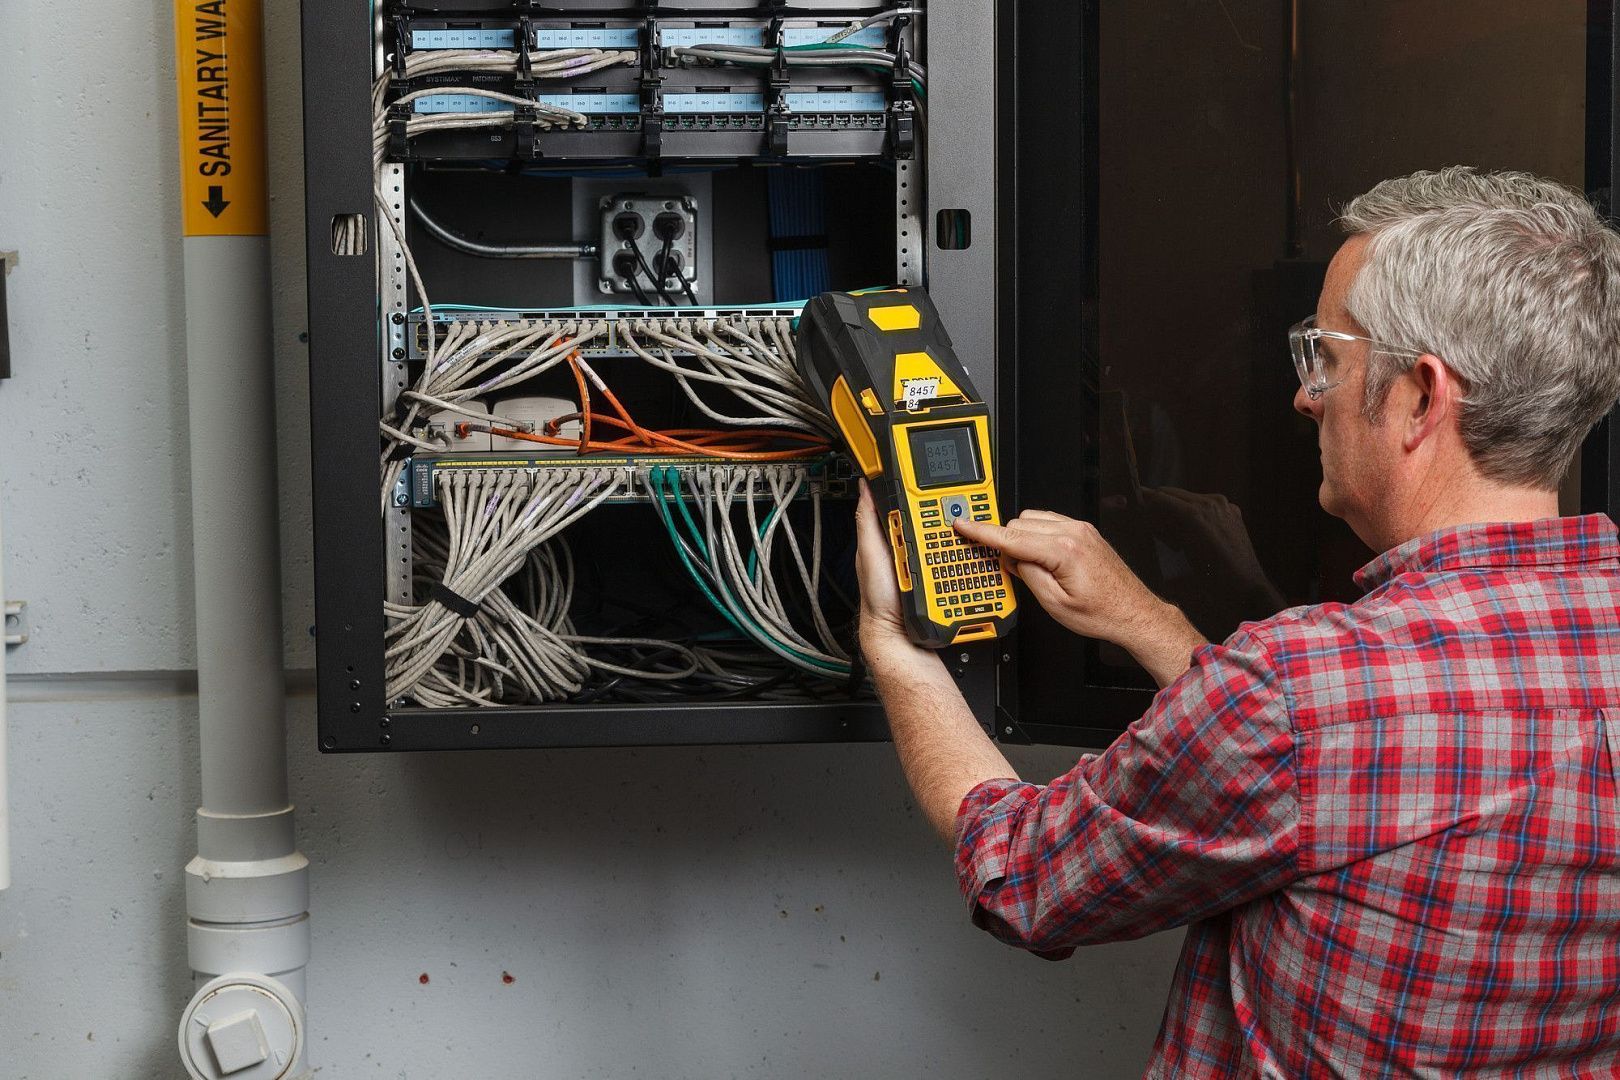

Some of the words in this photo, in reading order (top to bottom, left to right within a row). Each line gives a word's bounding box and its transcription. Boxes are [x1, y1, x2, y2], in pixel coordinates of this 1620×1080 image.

[196, 0, 227, 41] WA
[196, 49, 231, 176] SANITARY
[909, 385, 935, 397] 8457
[927, 445, 955, 458] 8457
[930, 459, 957, 472] 8457
